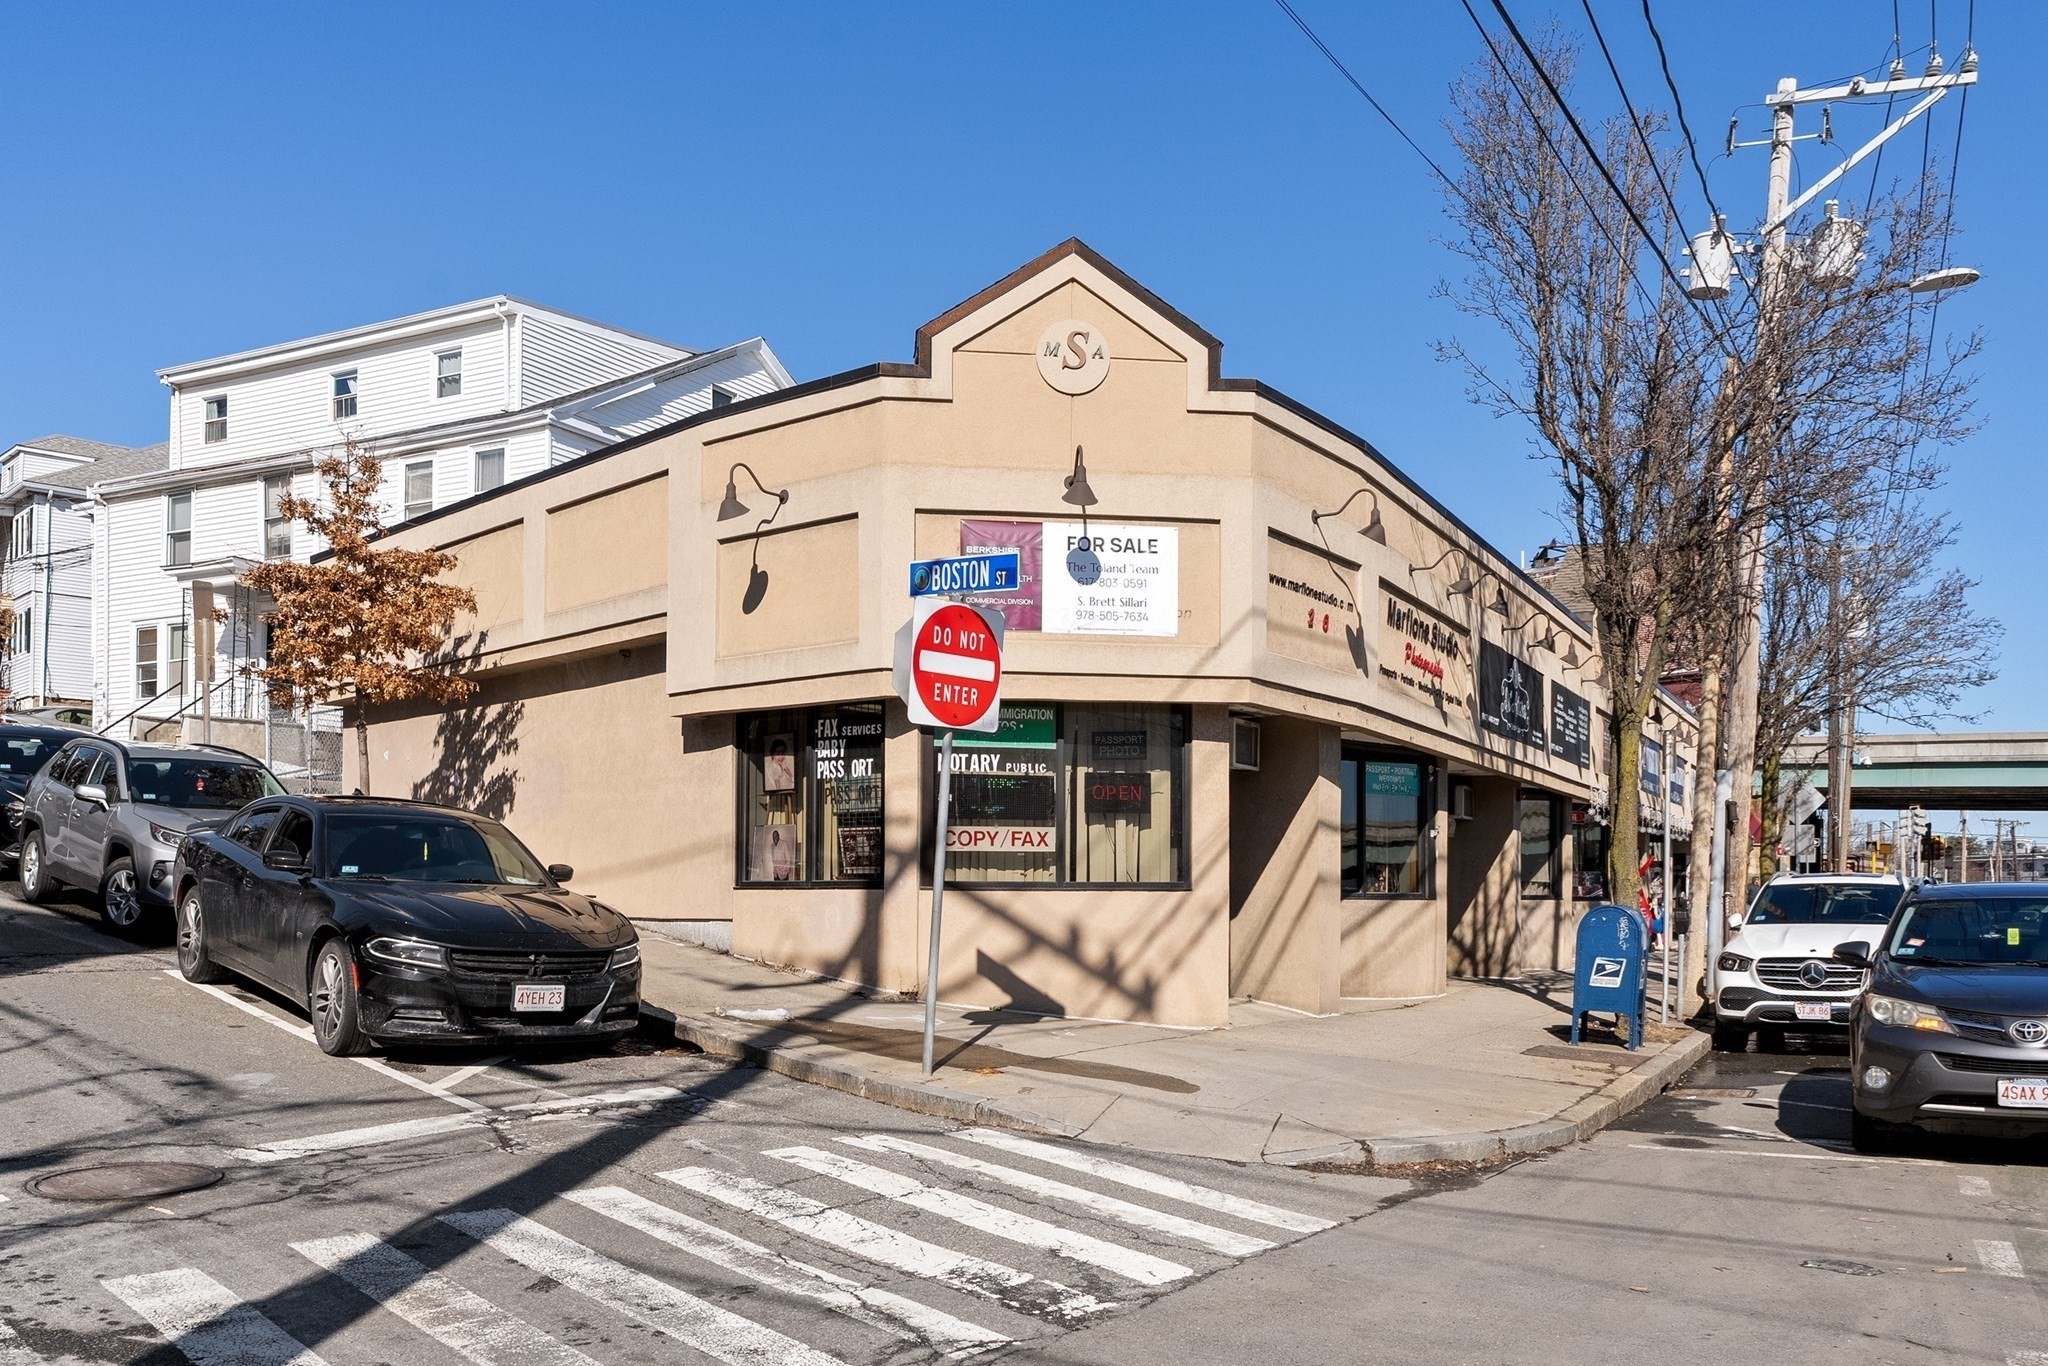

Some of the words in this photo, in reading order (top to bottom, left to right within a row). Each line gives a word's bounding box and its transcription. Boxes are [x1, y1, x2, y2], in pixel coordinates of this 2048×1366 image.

[1067, 536, 1105, 552] FOR
[1110, 537, 1158, 554] SALE
[932, 560, 990, 591] BOSTON
[995, 571, 1007, 586] ST
[1066, 562, 1087, 573] The
[1090, 562, 1126, 574] Toland
[1129, 564, 1159, 575] Team
[1077, 577, 1148, 588] 617-803-0591
[966, 597, 1007, 605] COMMERCIAL
[1077, 596, 1086, 607] S.
[1089, 597, 1116, 608] Brett
[1119, 598, 1148, 608] Sillari
[1075, 610, 1149, 622] 978-505-7634
[1387, 597, 1430, 645] Marfione
[1431, 622, 1458, 661] Studio
[933, 625, 952, 646] DO
[960, 629, 986, 652] NOT
[934, 682, 979, 707] ENTER
[999, 707, 1054, 720] MMIGRATION
[817, 718, 838, 738] FAX
[841, 723, 882, 737] SERVICES
[1094, 735, 1144, 745] PASSPORT
[817, 739, 847, 759] BABY
[1099, 745, 1141, 757] PHOTO
[1005, 762, 1047, 773] PUBLIC
[1092, 784, 1142, 801] OPEN
[946, 829, 1049, 848] COPY/FAX
[517, 991, 546, 1005] 4YEH
[548, 991, 563, 1005] 23
[1818, 1006, 1829, 1016] 86
[2001, 1085, 2036, 1100] 4SAX
